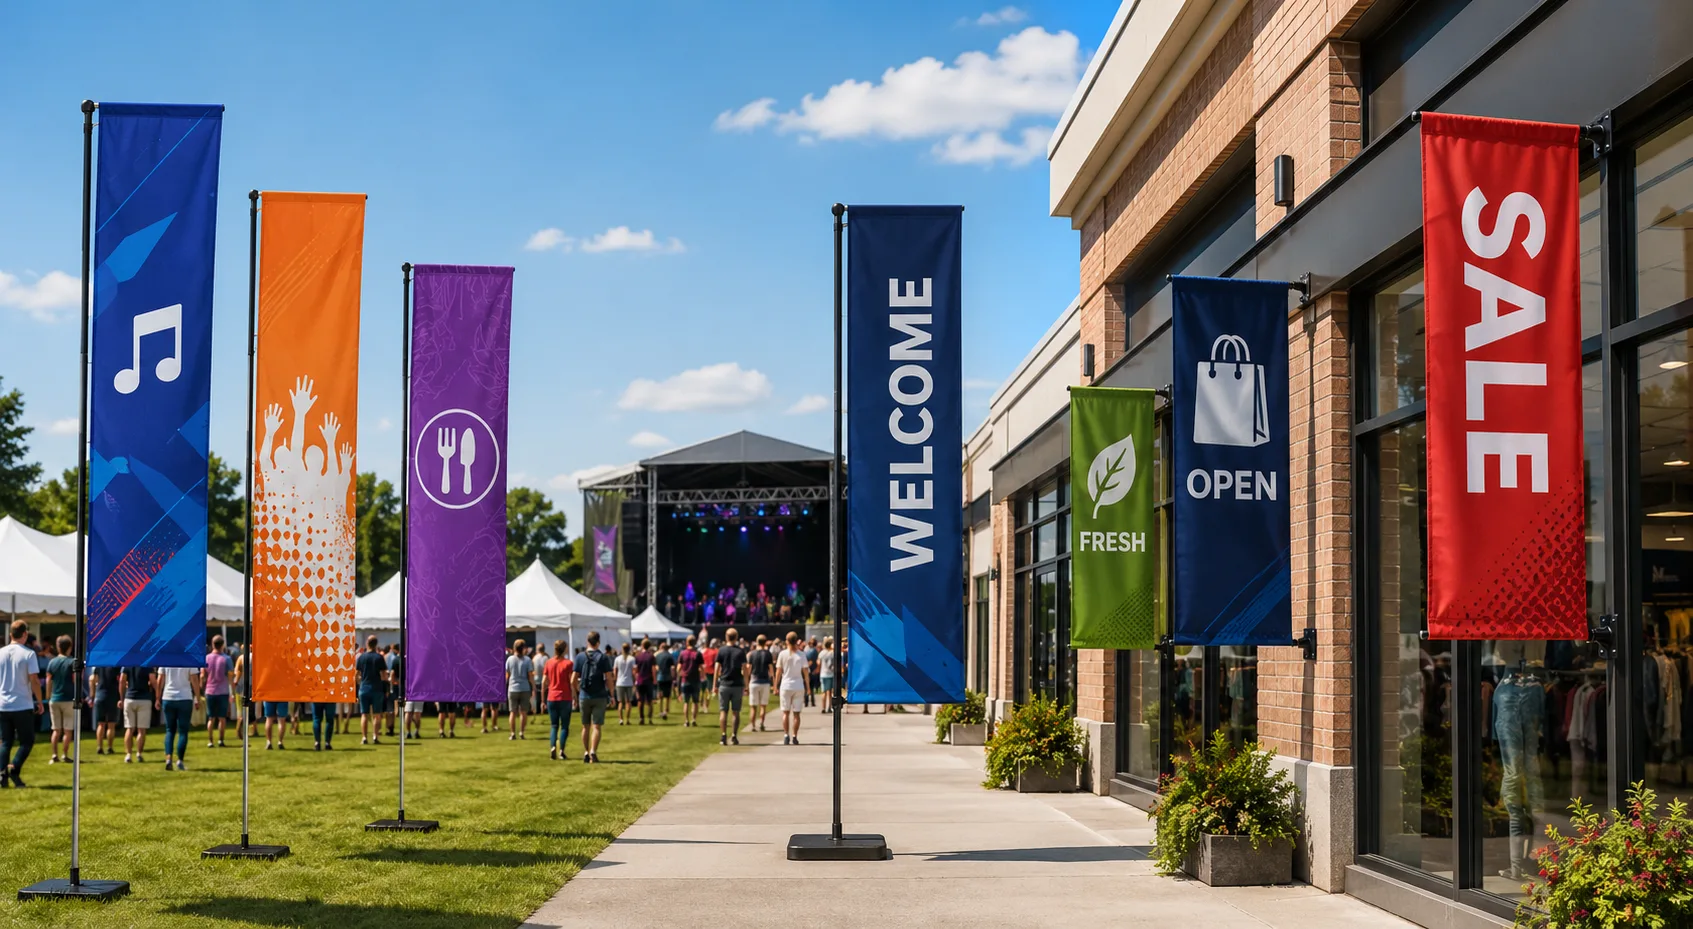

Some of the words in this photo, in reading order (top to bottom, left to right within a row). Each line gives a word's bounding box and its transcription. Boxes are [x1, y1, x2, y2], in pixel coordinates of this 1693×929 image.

[1461, 186, 1549, 494] SALE
[888, 277, 934, 573] WELCOME
[1186, 468, 1278, 501] OPEN
[1080, 531, 1147, 553] FRESH
